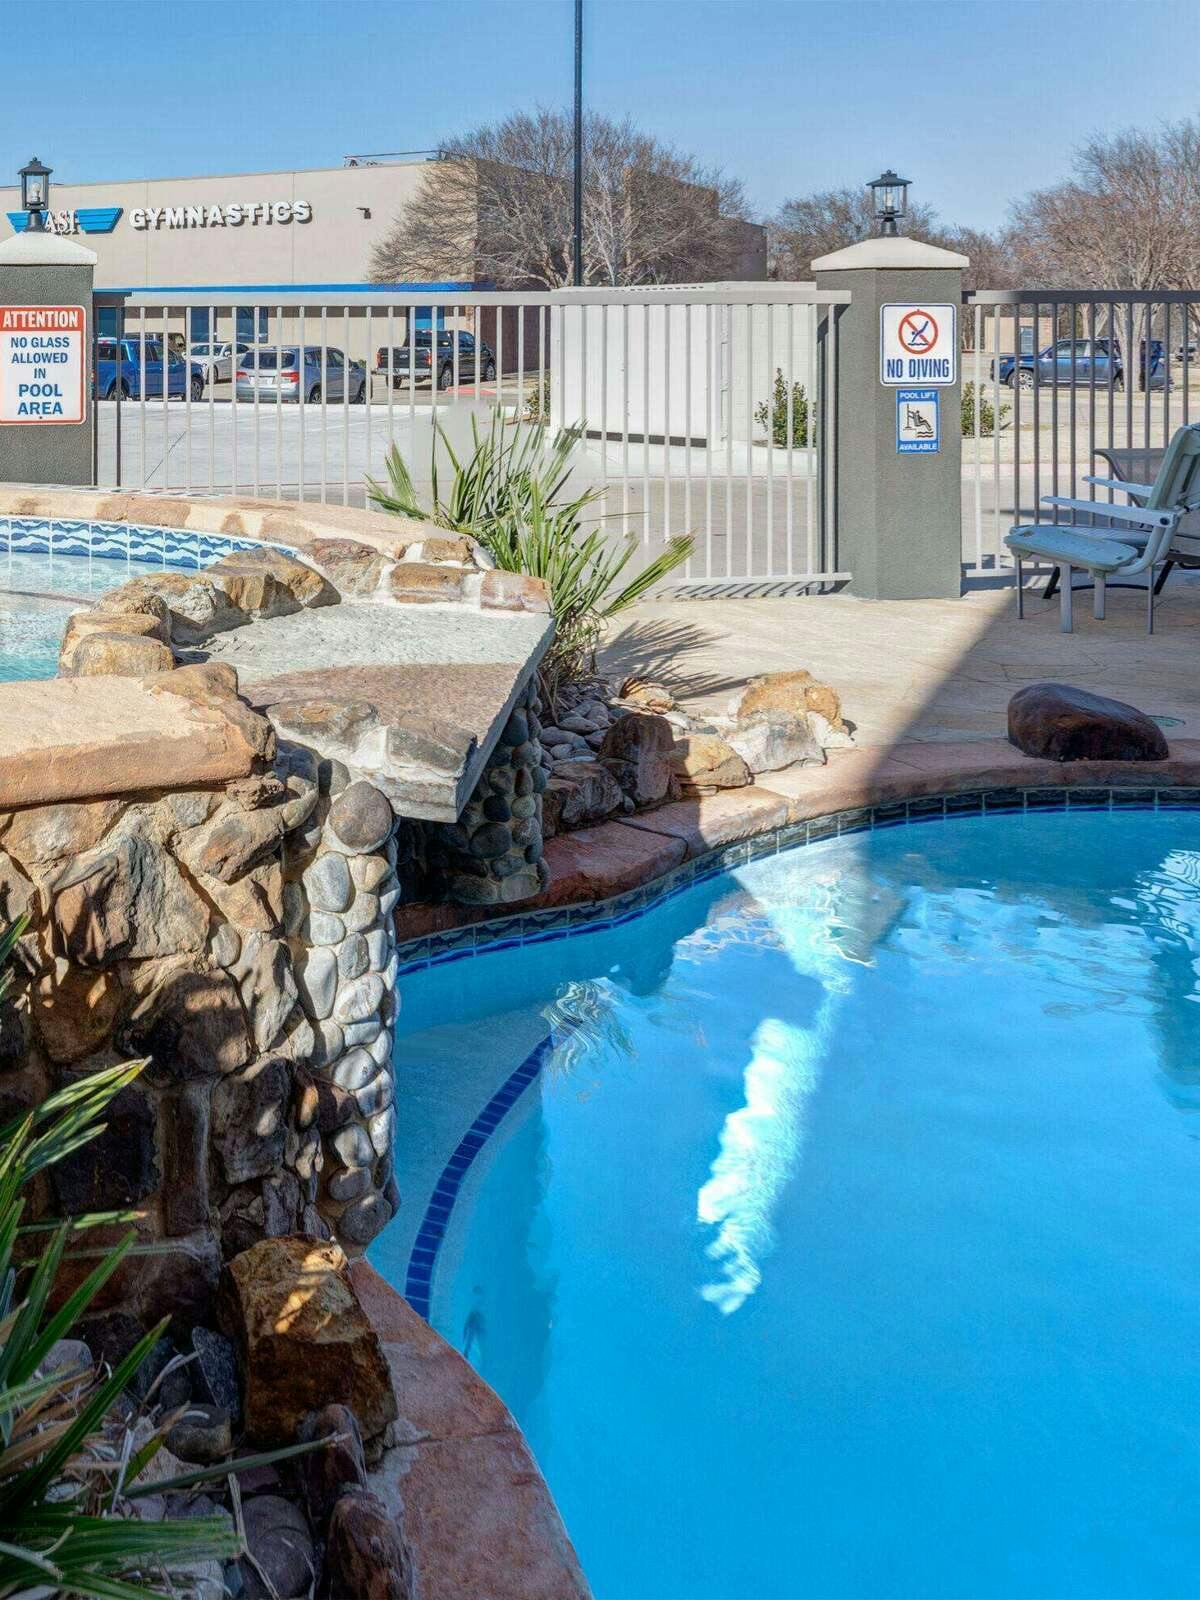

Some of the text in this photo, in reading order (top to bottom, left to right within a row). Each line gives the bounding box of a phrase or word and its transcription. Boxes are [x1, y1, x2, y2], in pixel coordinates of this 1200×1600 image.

[129, 200, 312, 228] GYMNASTICS
[2, 310, 79, 328] ATTENTION
[10, 336, 70, 348] NO GLASS
[11, 352, 68, 364] ALLOWED
[33, 368, 46, 379] IN
[887, 358, 949, 378] NO DIVING
[18, 383, 62, 397] POOL
[900, 391, 936, 399] POOL LIFT
[17, 402, 63, 415] AREA
[899, 443, 937, 451] AVAILABLE
